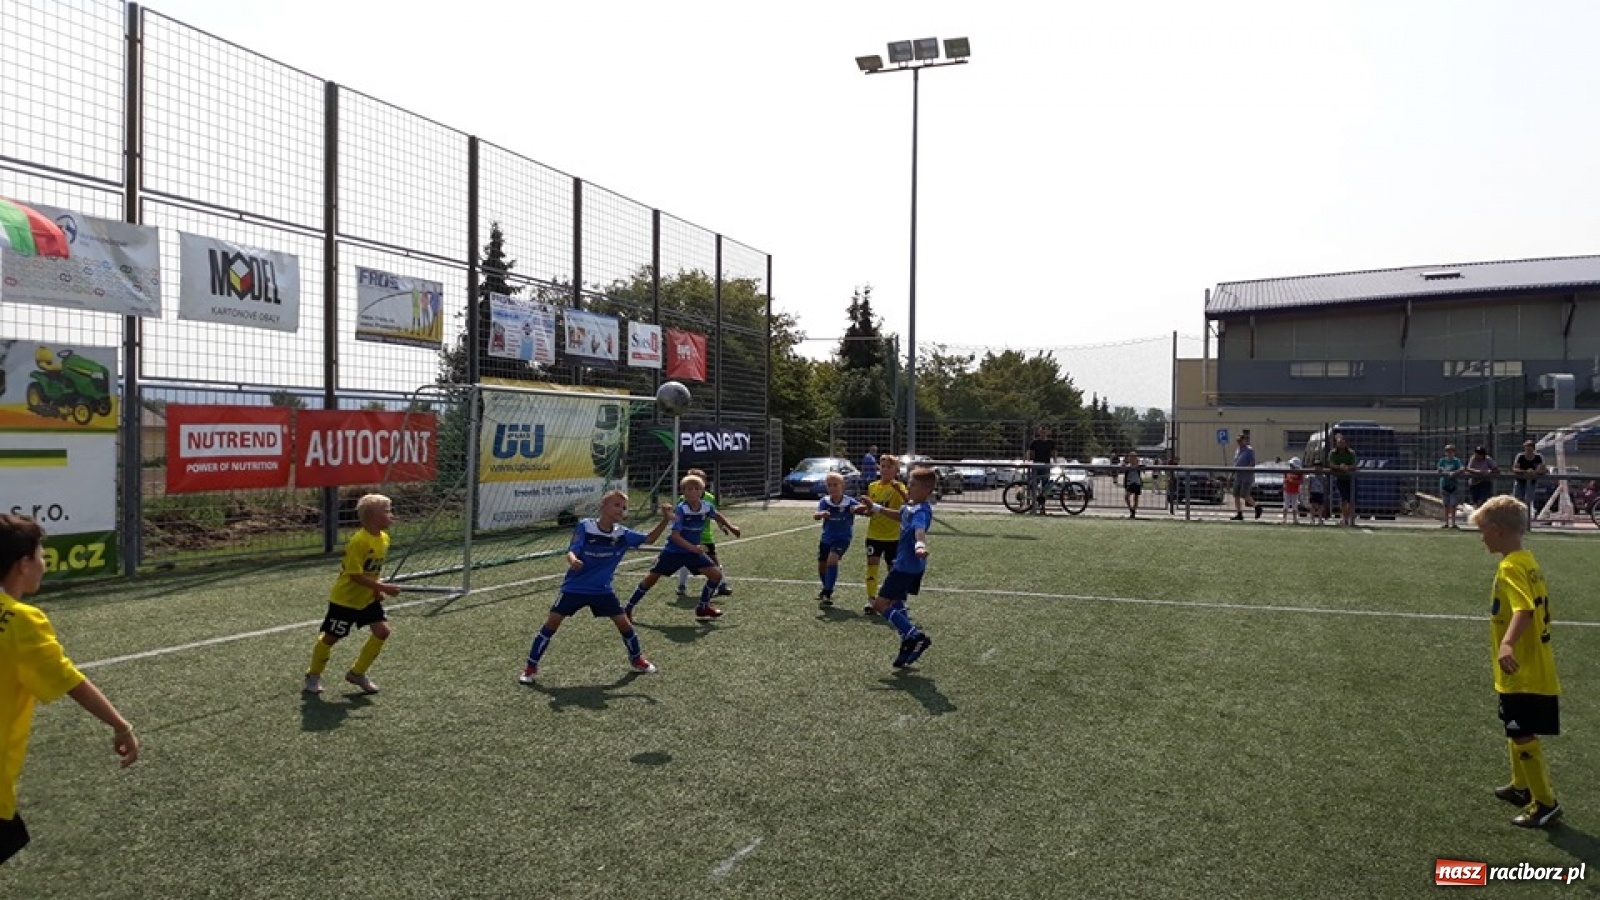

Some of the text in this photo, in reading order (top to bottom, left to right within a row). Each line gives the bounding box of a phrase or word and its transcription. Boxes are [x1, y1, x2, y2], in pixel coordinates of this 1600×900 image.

[208, 247, 282, 305] MODEL
[187, 431, 278, 450] NUTREND
[305, 429, 431, 467] AUTOCONT
[680, 431, 751, 453] PENALTY
[186, 461, 279, 473] POWER OF NUTRITION
[329, 618, 349, 635] 15
